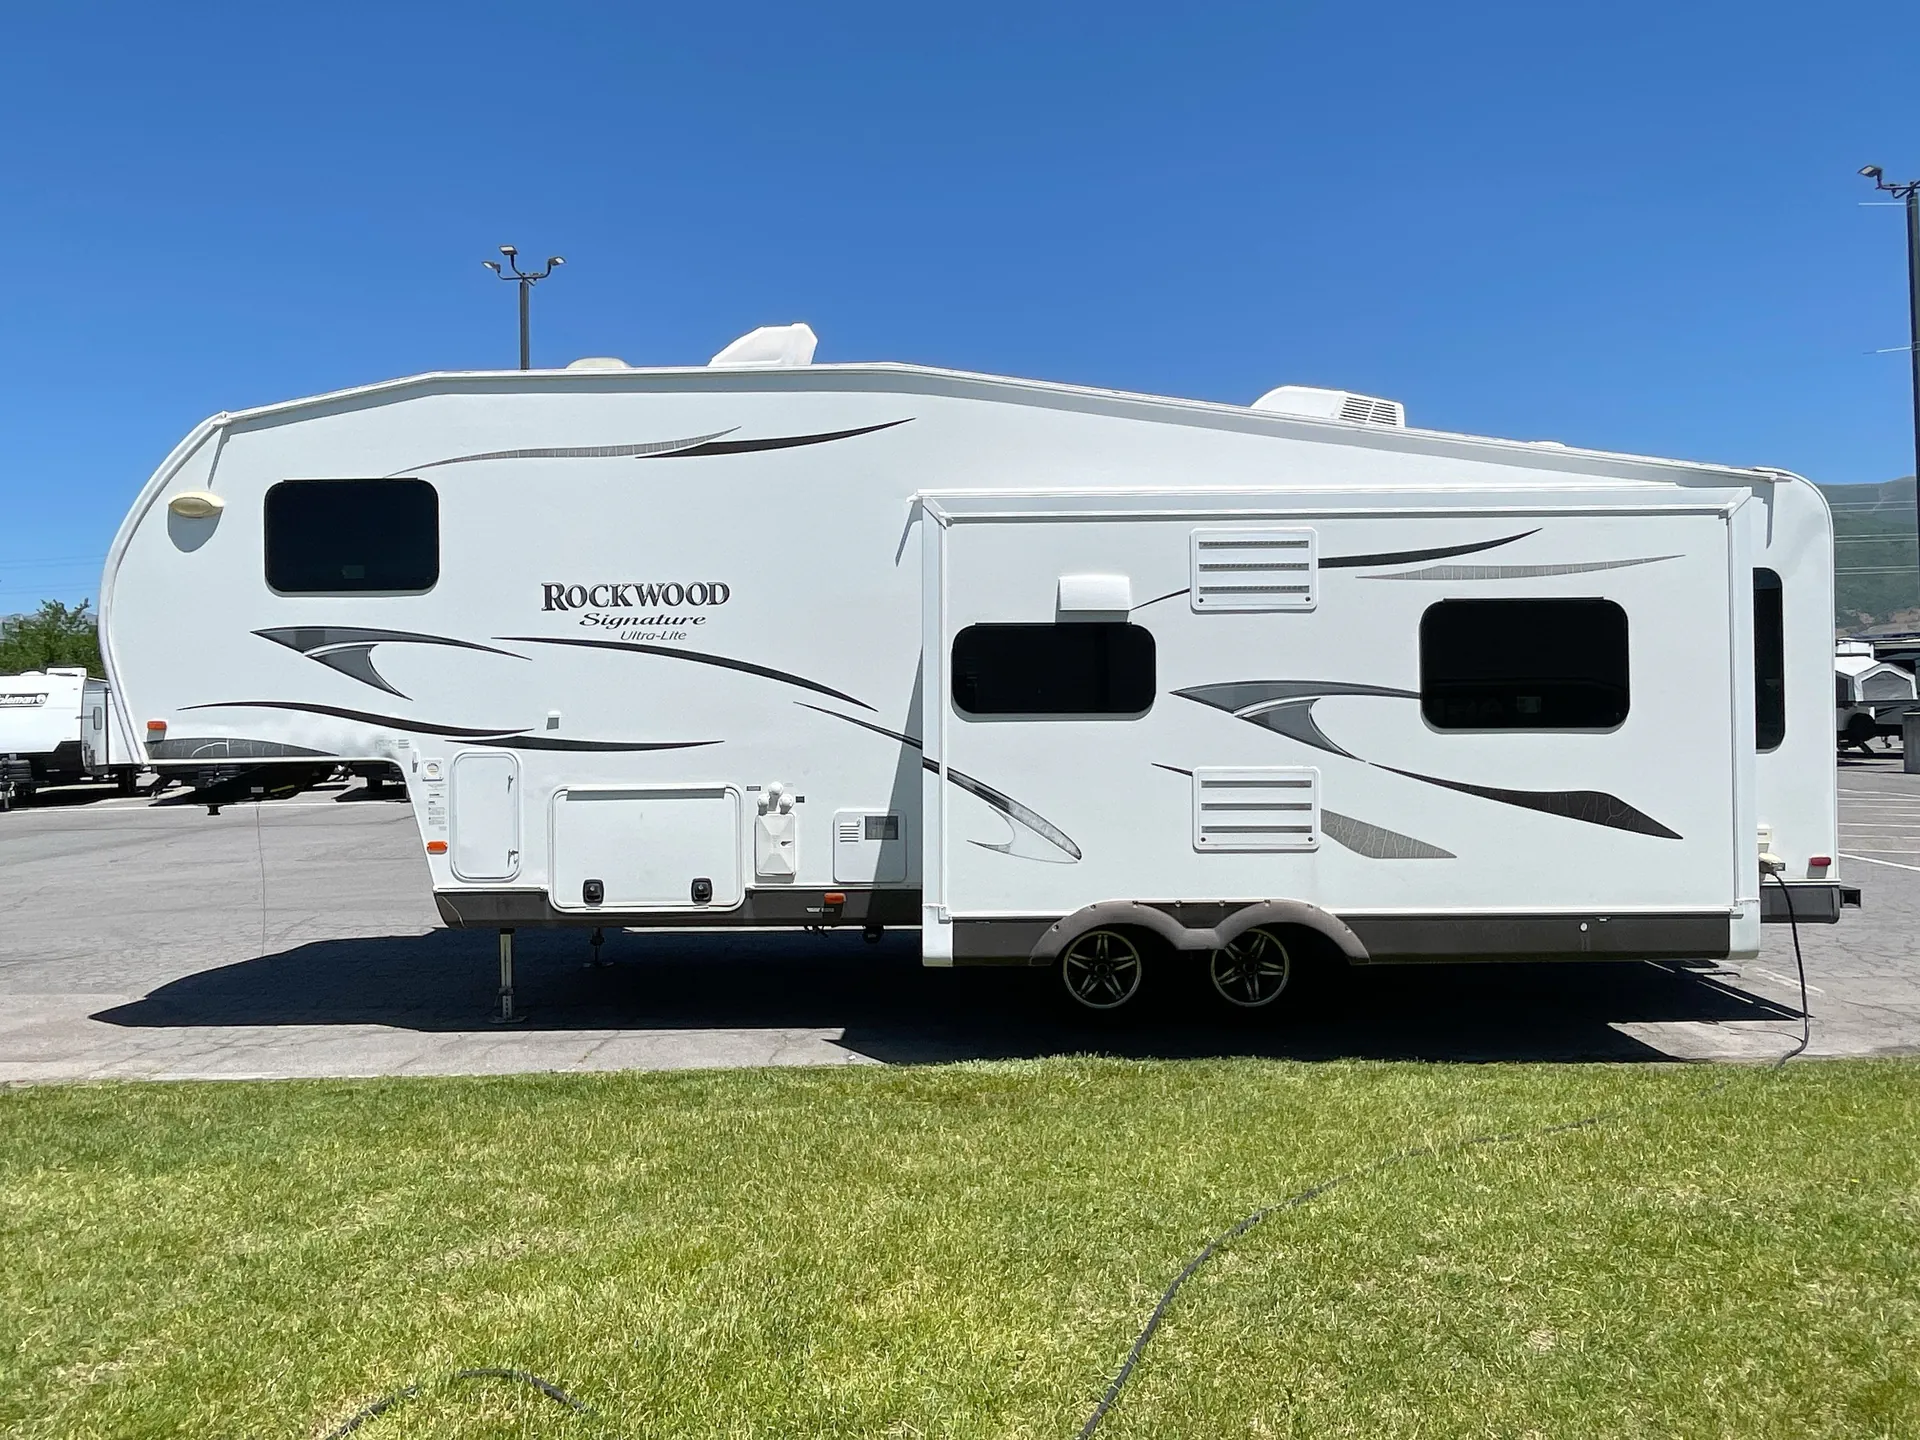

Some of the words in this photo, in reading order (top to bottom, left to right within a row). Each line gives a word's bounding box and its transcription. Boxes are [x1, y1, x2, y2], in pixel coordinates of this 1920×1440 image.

[541, 582, 730, 611] ROCKWOOD
[579, 612, 706, 630] Signature
[620, 630, 687, 641] Ultra-Lite
[0, 694, 35, 704] oleman
